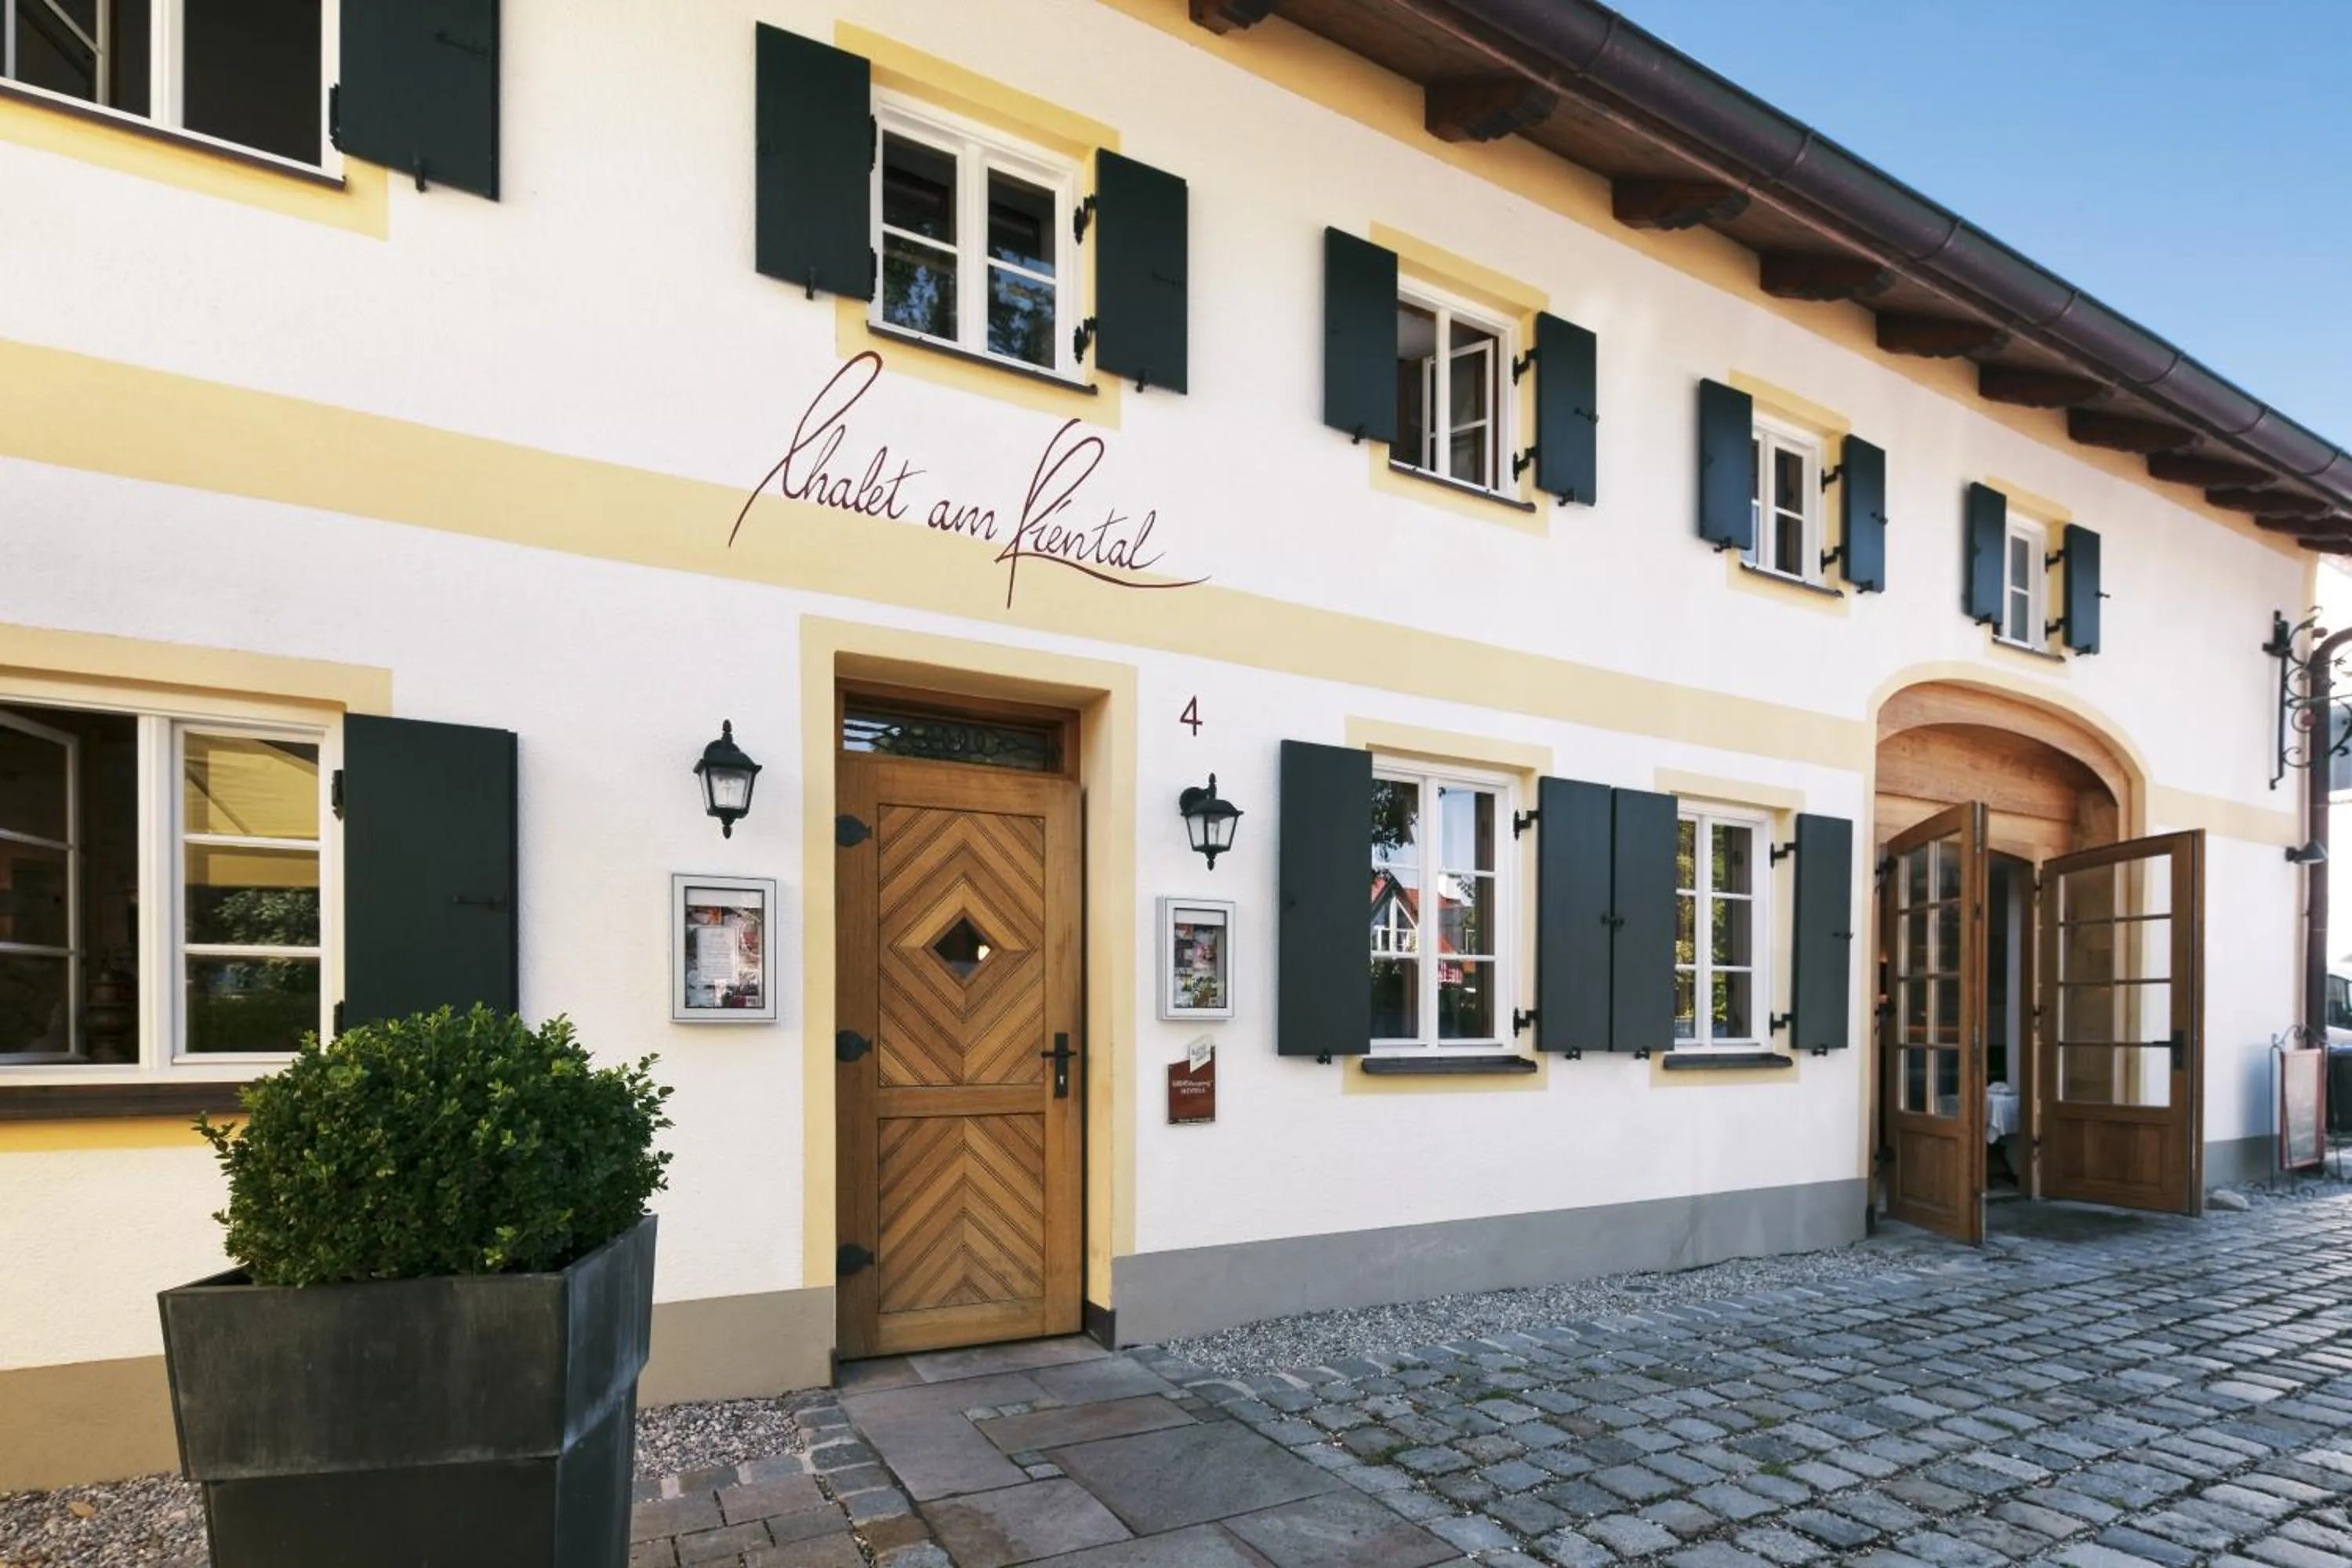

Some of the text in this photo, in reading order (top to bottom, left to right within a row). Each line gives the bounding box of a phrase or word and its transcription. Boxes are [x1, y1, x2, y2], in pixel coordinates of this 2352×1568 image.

[728, 350, 927, 547] Chalet
[927, 497, 998, 540] am
[1179, 695, 1203, 736] 4
